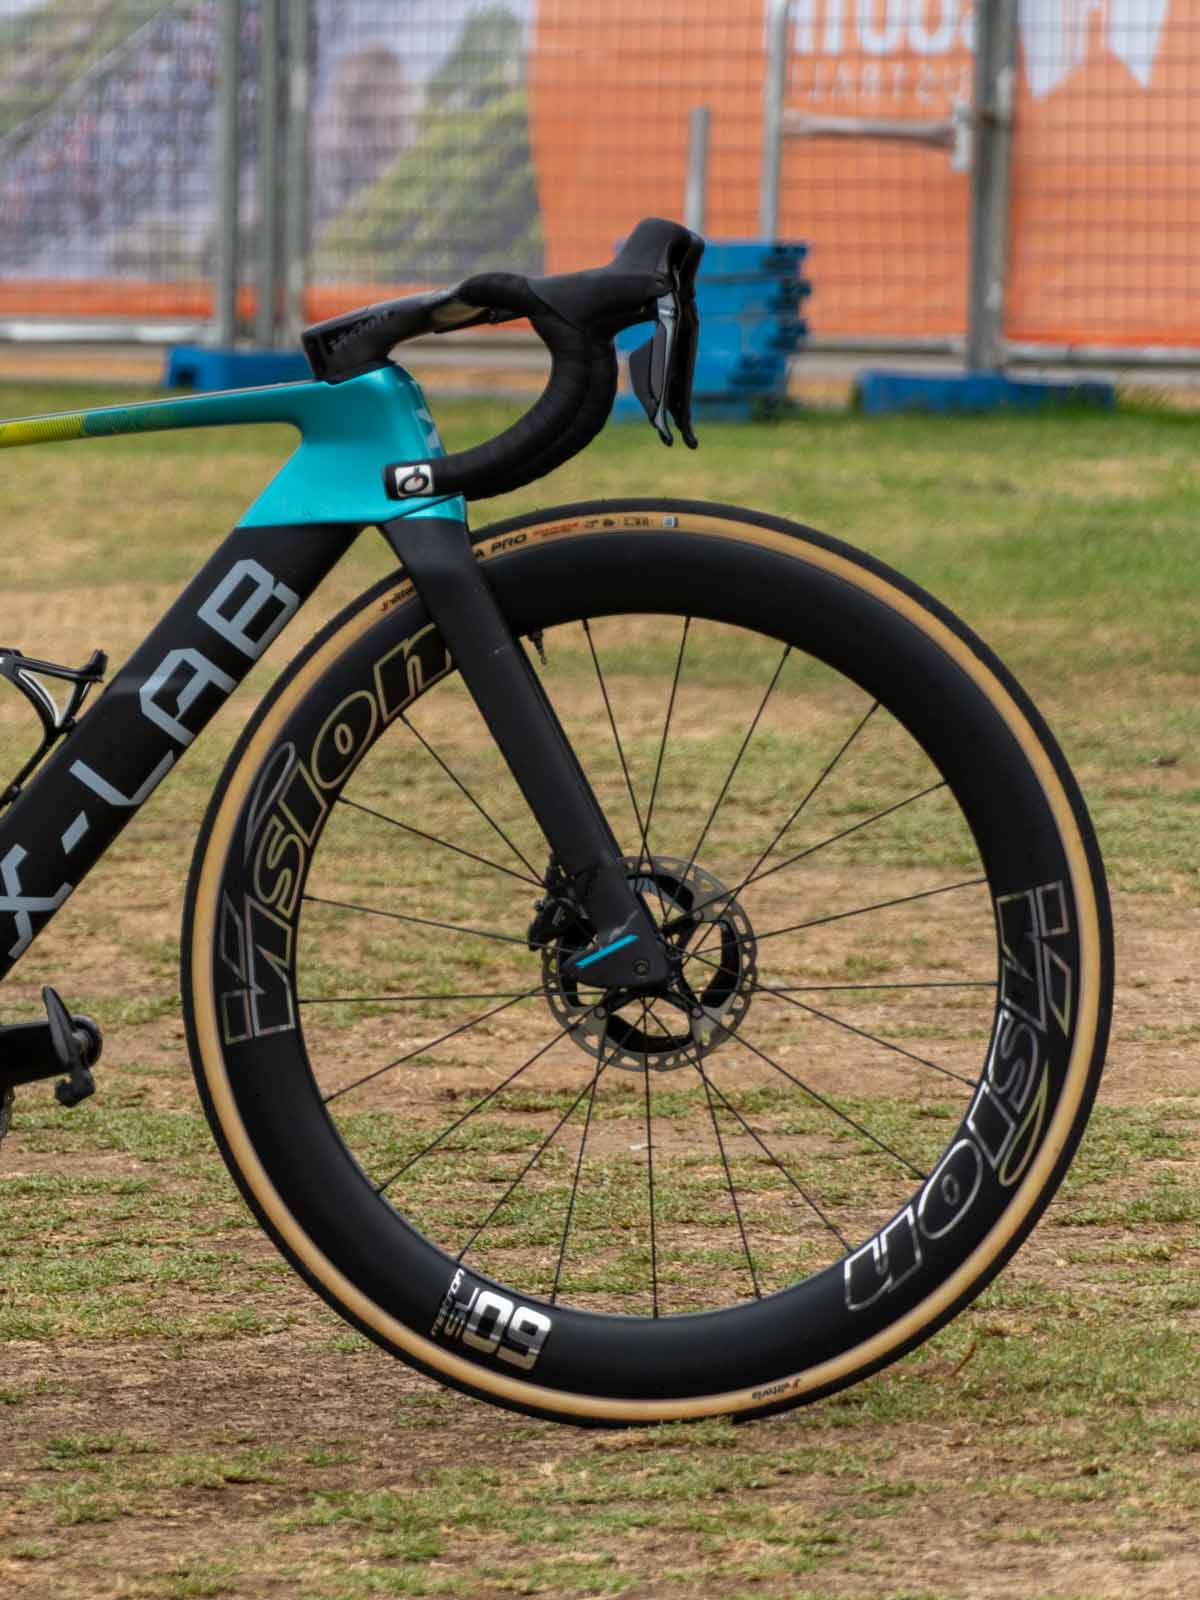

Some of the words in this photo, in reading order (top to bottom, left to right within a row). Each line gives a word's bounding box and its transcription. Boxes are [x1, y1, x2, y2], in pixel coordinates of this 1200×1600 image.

[491, 533, 528, 553] PRO
[222, 622, 453, 1044] Vision
[844, 880, 1071, 1311] Vision
[464, 1290, 552, 1370] 60
